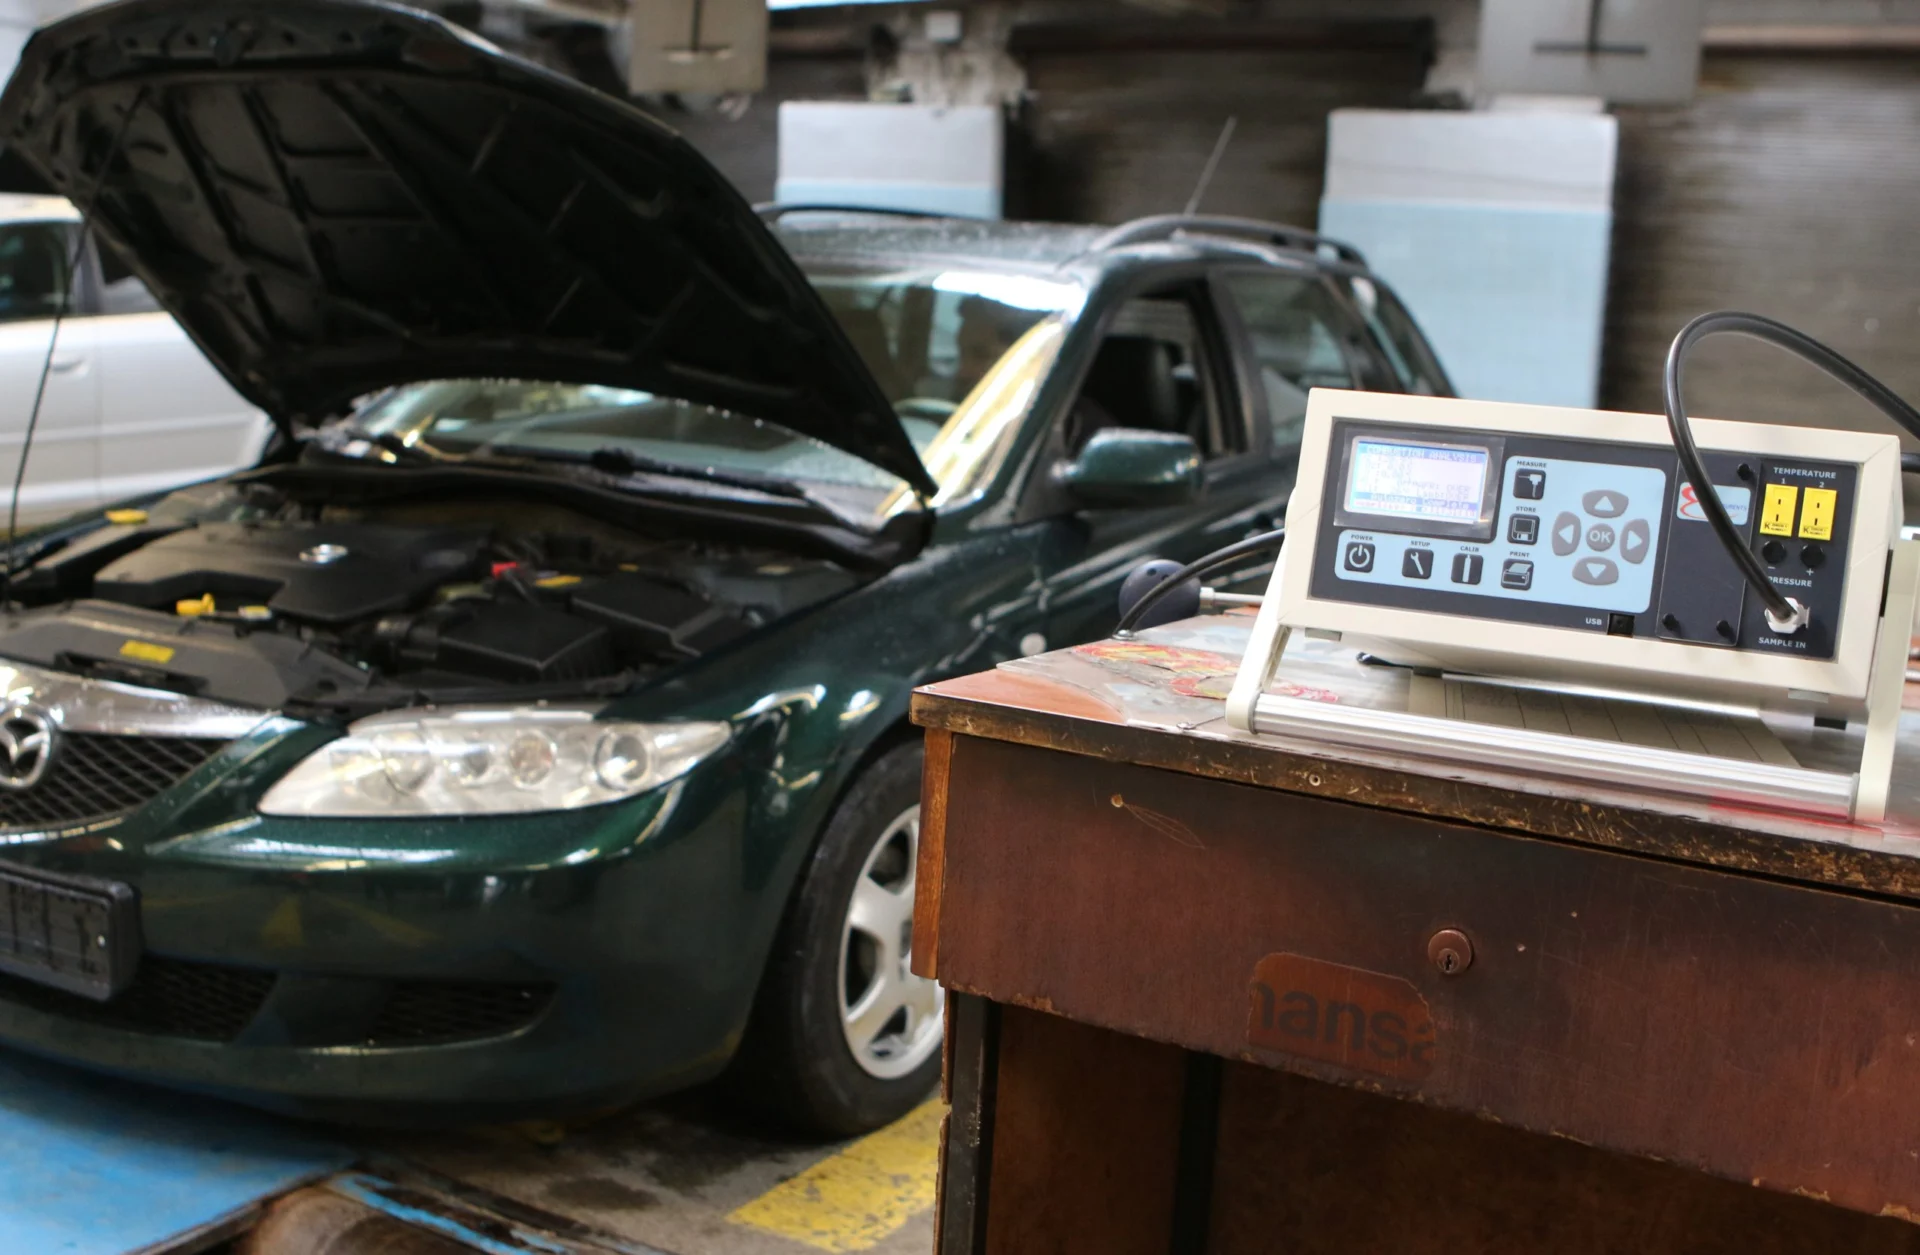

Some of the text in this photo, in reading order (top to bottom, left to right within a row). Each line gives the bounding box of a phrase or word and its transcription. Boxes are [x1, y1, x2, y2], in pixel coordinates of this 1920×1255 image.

[1429, 451, 1477, 463] ANALYSIS
[1516, 460, 1547, 469] MEASURE
[1773, 467, 1837, 479] TEMPERATURE
[1589, 530, 1611, 544] OK
[1585, 617, 1602, 625] USB
[1758, 637, 1807, 649] SAMPLE IN
